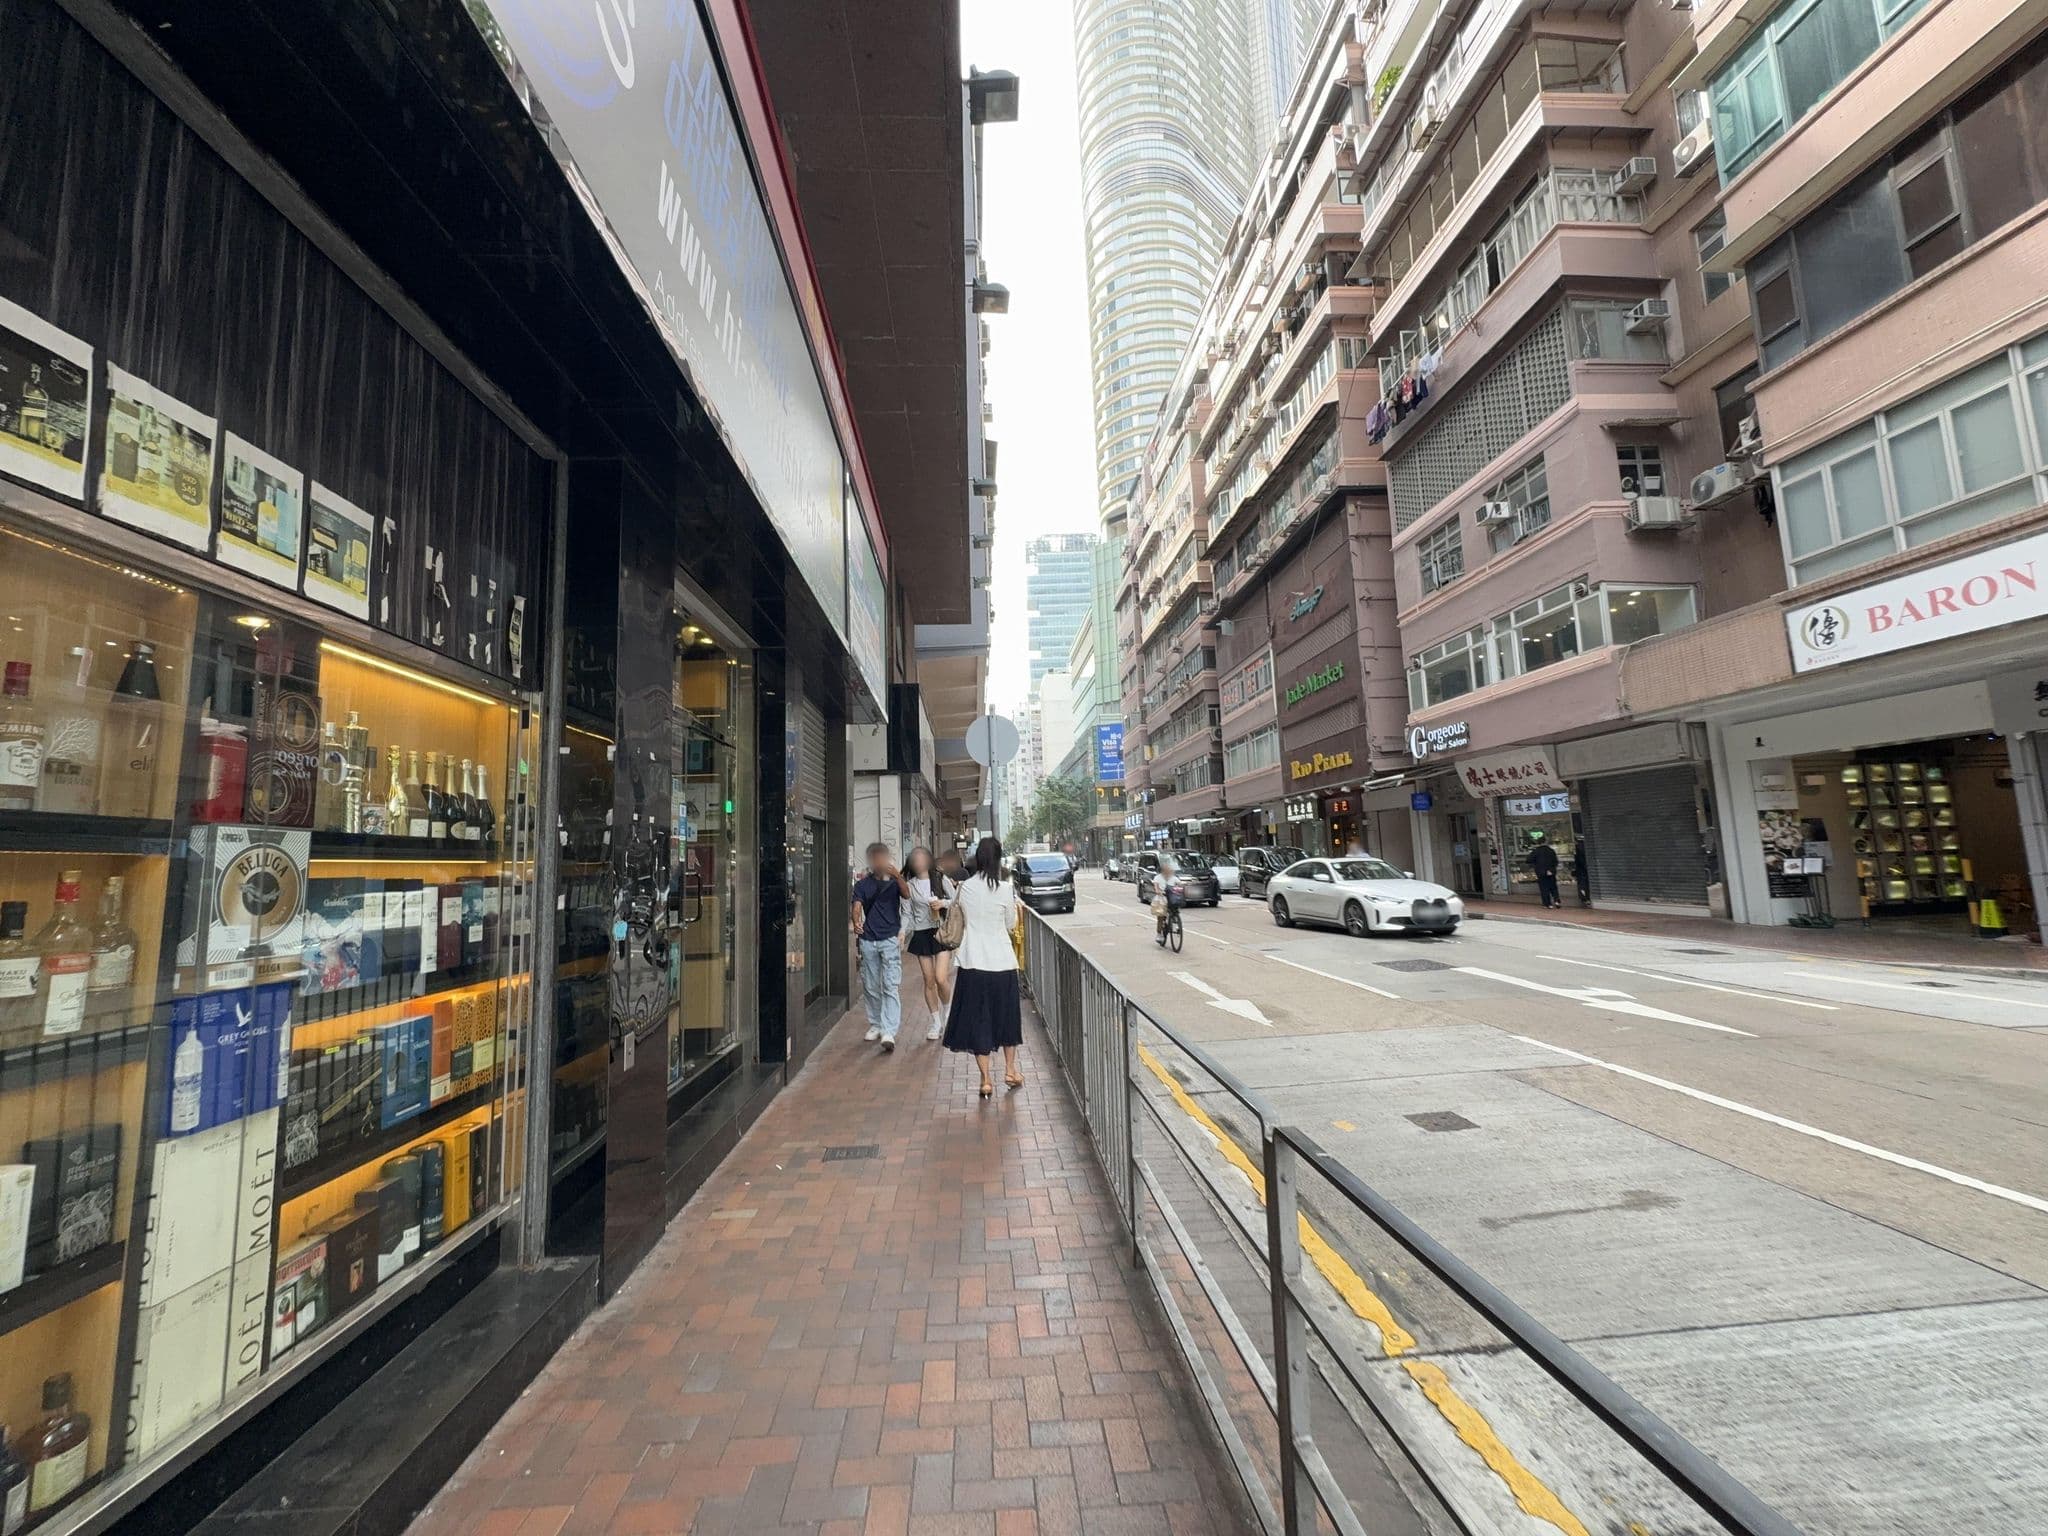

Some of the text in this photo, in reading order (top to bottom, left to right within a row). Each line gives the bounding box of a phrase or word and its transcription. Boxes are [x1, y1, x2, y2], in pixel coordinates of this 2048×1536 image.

[1866, 561, 2037, 634] BARON
[1306, 661, 1344, 697] Market
[1409, 721, 1467, 759] Gorgeous
[1312, 751, 1353, 774] PEARL
[237, 852, 289, 878] BELUGA
[257, 963, 281, 975] ELUGA
[218, 1031, 240, 1044] GREY
[249, 1147, 276, 1252] MOËT
